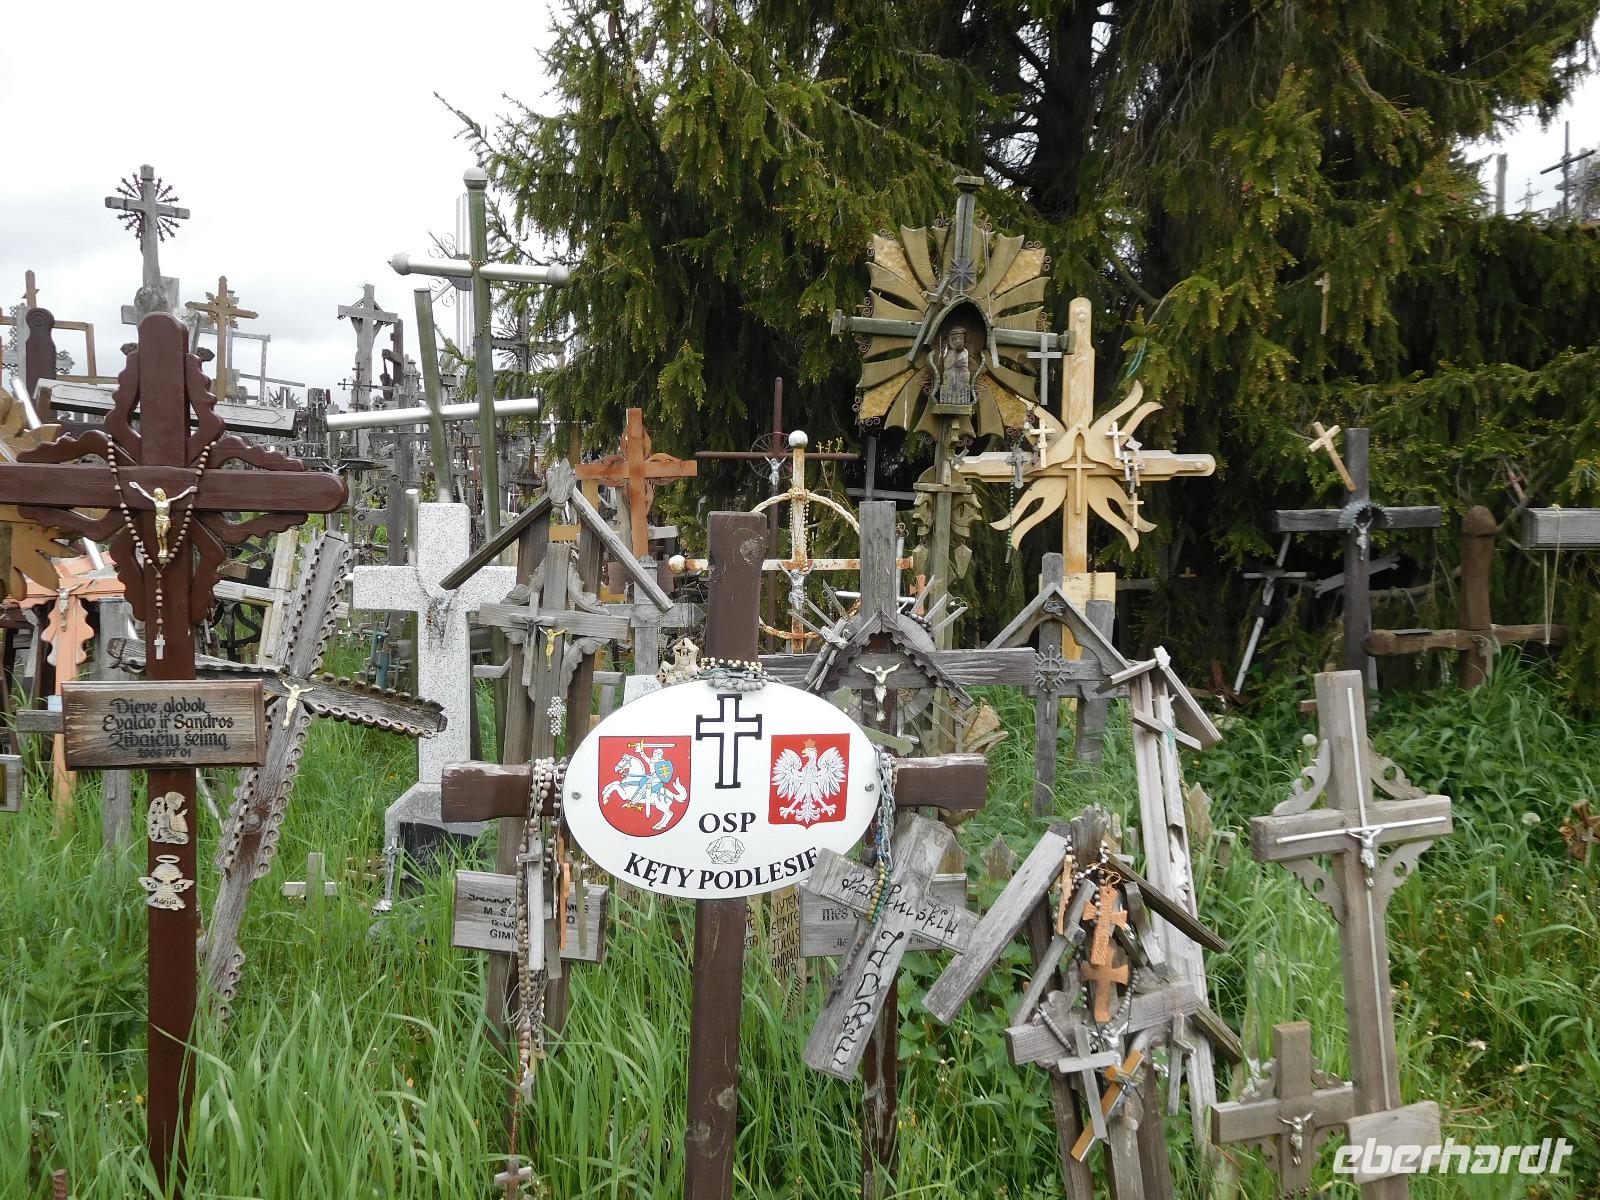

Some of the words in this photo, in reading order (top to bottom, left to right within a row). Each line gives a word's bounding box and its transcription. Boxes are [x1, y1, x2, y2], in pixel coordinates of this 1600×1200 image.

[163, 696, 211, 717] globok
[102, 714, 156, 732] Evaldo
[159, 715, 172, 729] ir
[173, 713, 234, 729] Sandros
[698, 812, 757, 834] OSP
[623, 851, 695, 887] KĘTY
